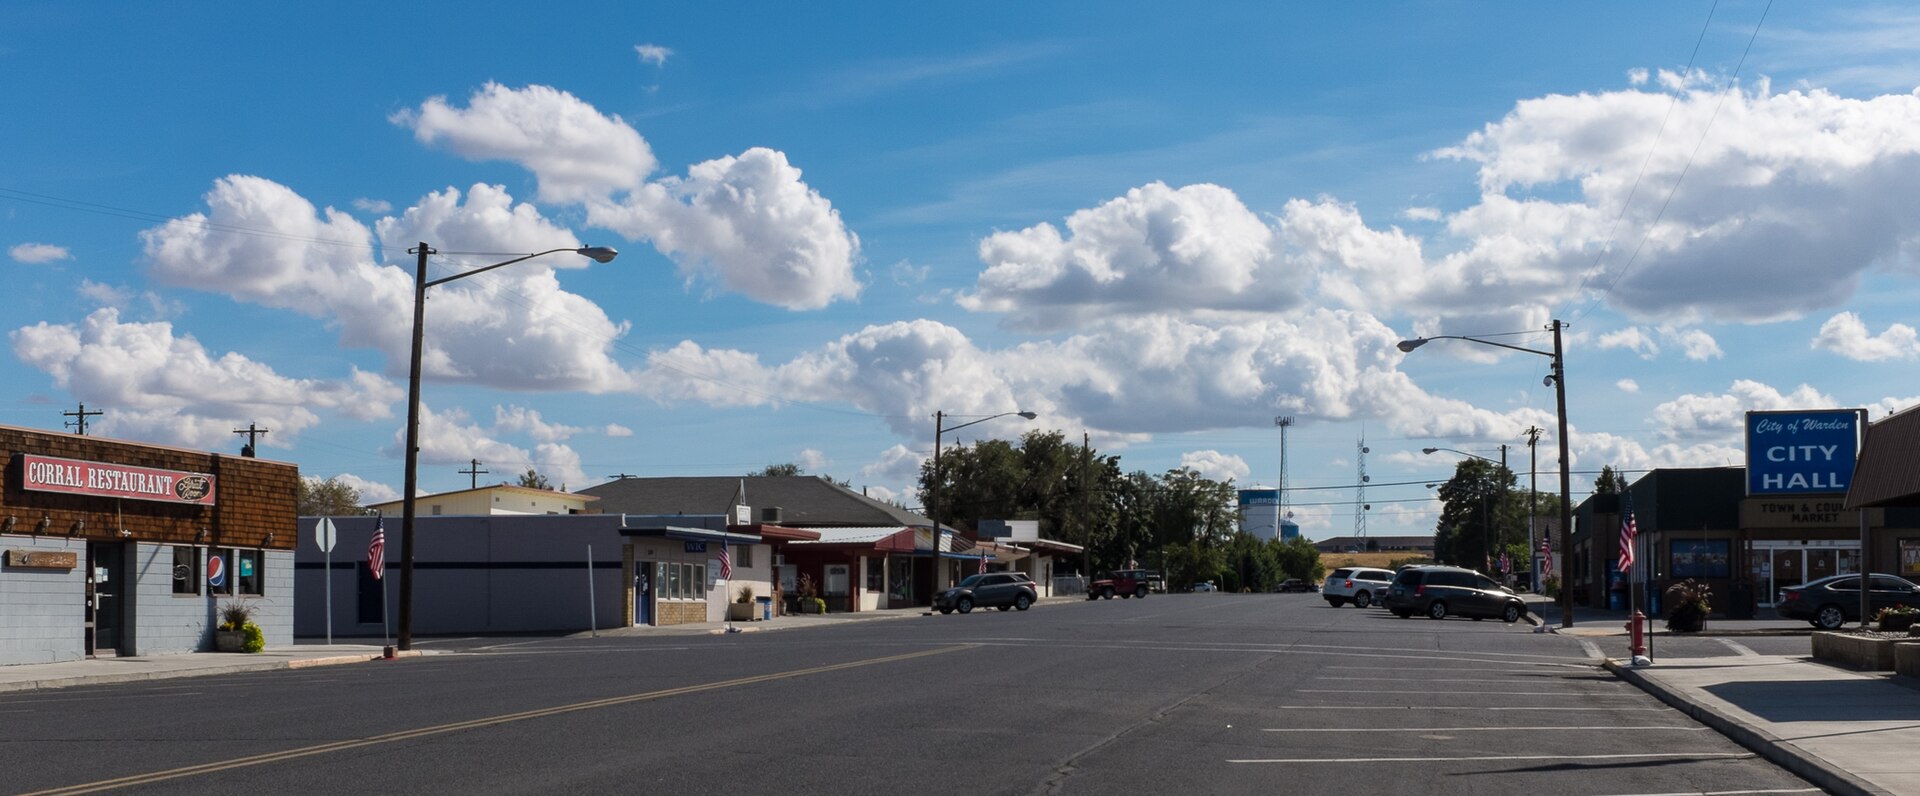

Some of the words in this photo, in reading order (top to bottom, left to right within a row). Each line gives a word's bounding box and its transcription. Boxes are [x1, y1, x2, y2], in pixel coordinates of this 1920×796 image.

[1756, 418, 1783, 434] City
[1787, 419, 1799, 434] of
[1802, 418, 1849, 430] Warden
[1766, 445, 1838, 462] CITY
[29, 462, 83, 487] CORRAL
[88, 468, 172, 496] RESTAURANT
[1762, 472, 1844, 489] HALL
[1761, 503, 1795, 512] TOWN
[1801, 503, 1810, 512] &
[1816, 503, 1861, 512] COUN
[1791, 513, 1839, 522] MARKET
[687, 543, 705, 552] WIC
